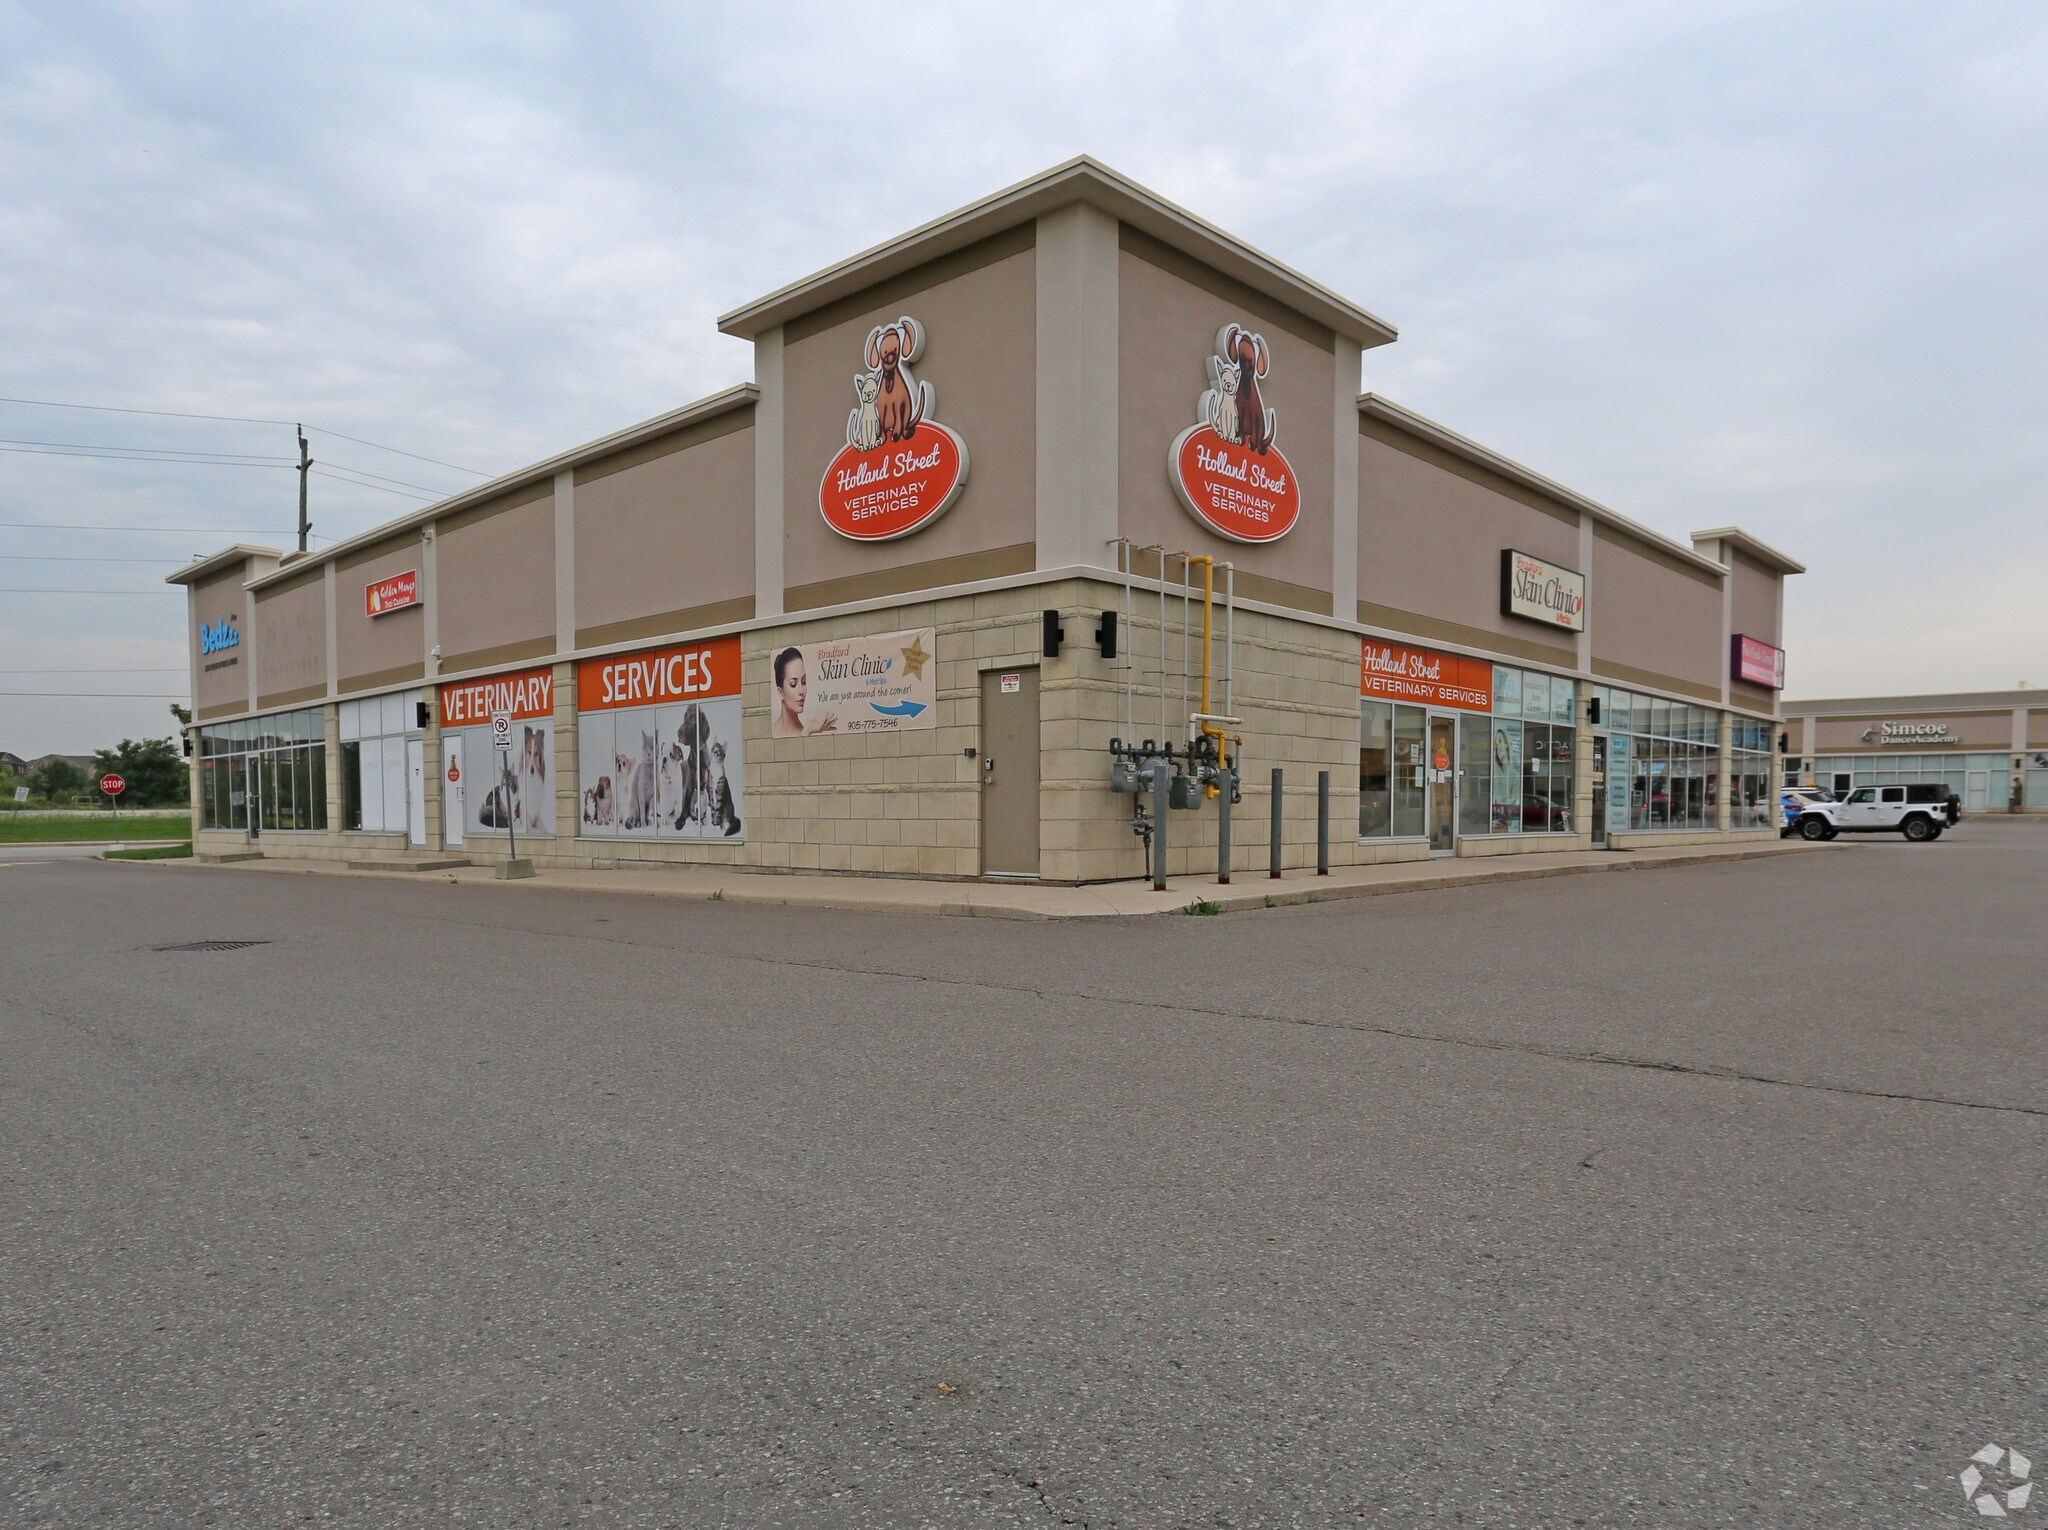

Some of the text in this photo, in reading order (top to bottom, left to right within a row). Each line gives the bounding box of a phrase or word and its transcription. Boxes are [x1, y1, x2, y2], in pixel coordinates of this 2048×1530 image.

[837, 443, 940, 493] Holland Street
[1197, 444, 1286, 495] Holland Street
[844, 480, 928, 510] VETERINARY
[852, 496, 919, 521] SERVICES
[1204, 480, 1276, 512] VETERINARY
[1211, 496, 1269, 523] SERVICES
[1513, 569, 1578, 615] Skin Clinic
[817, 645, 850, 660] Bradford
[1364, 646, 1440, 680] Holland Street
[602, 650, 712, 703] SERVICES
[818, 660, 848, 681] Skin
[851, 654, 888, 677] Clinic
[444, 675, 552, 721] VETERINARY
[817, 691, 829, 703] We
[839, 692, 852, 704] just
[853, 687, 876, 699] around
[877, 686, 889, 697] the
[1364, 676, 1435, 698] VETERINARY
[1439, 687, 1488, 705] SERVICES
[847, 718, 898, 731] 905-775-7546
[1881, 721, 1947, 736] Simcoe
[1881, 734, 1960, 745] Dance Academy
[103, 780, 123, 789] STOP
